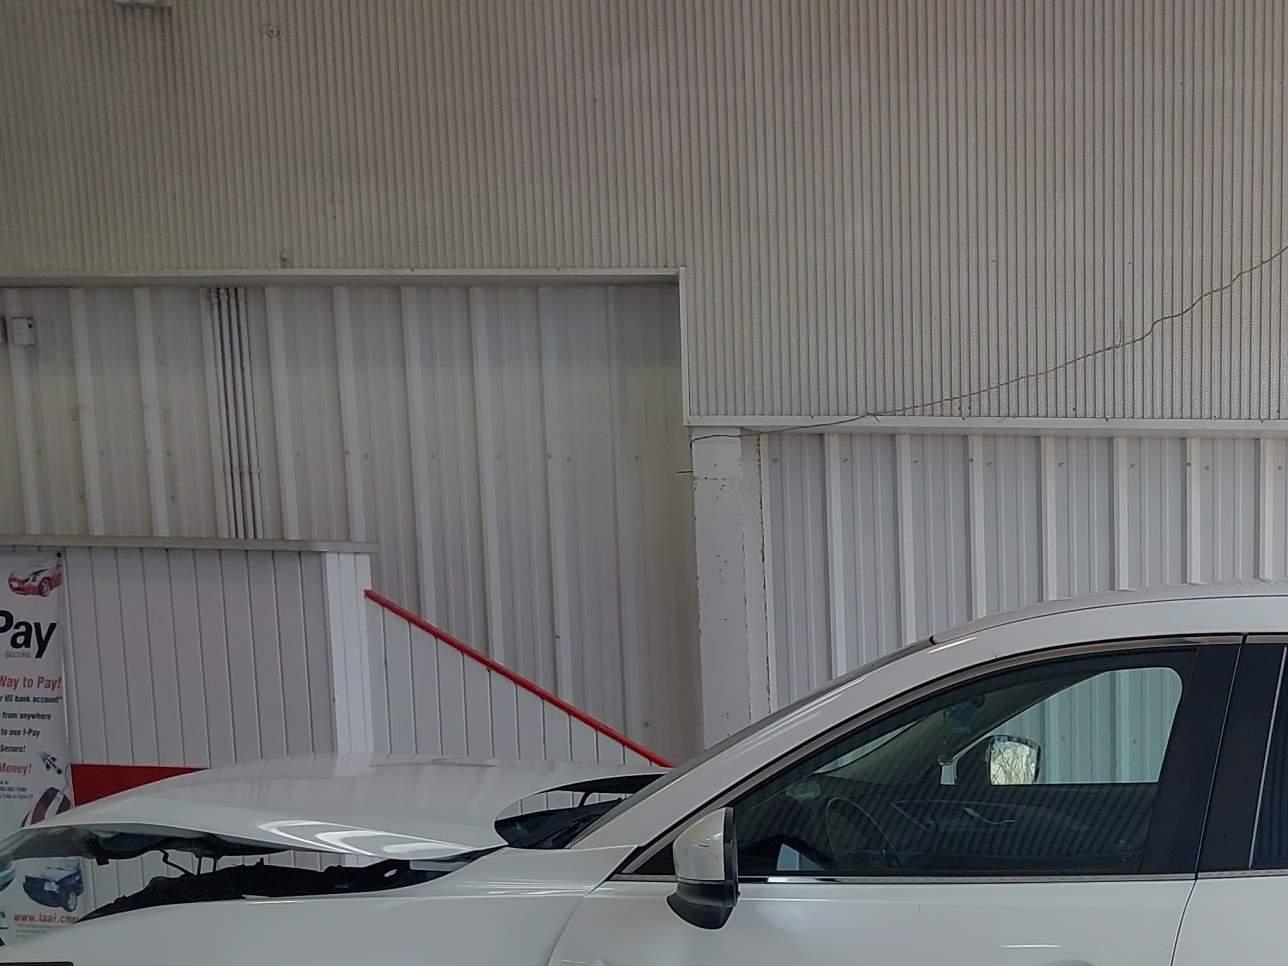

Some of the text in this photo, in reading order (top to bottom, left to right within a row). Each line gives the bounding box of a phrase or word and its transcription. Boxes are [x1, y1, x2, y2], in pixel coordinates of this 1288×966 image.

[0, 610, 57, 659] Pay
[23, 677, 33, 688] to
[37, 676, 62, 691] Pay!
